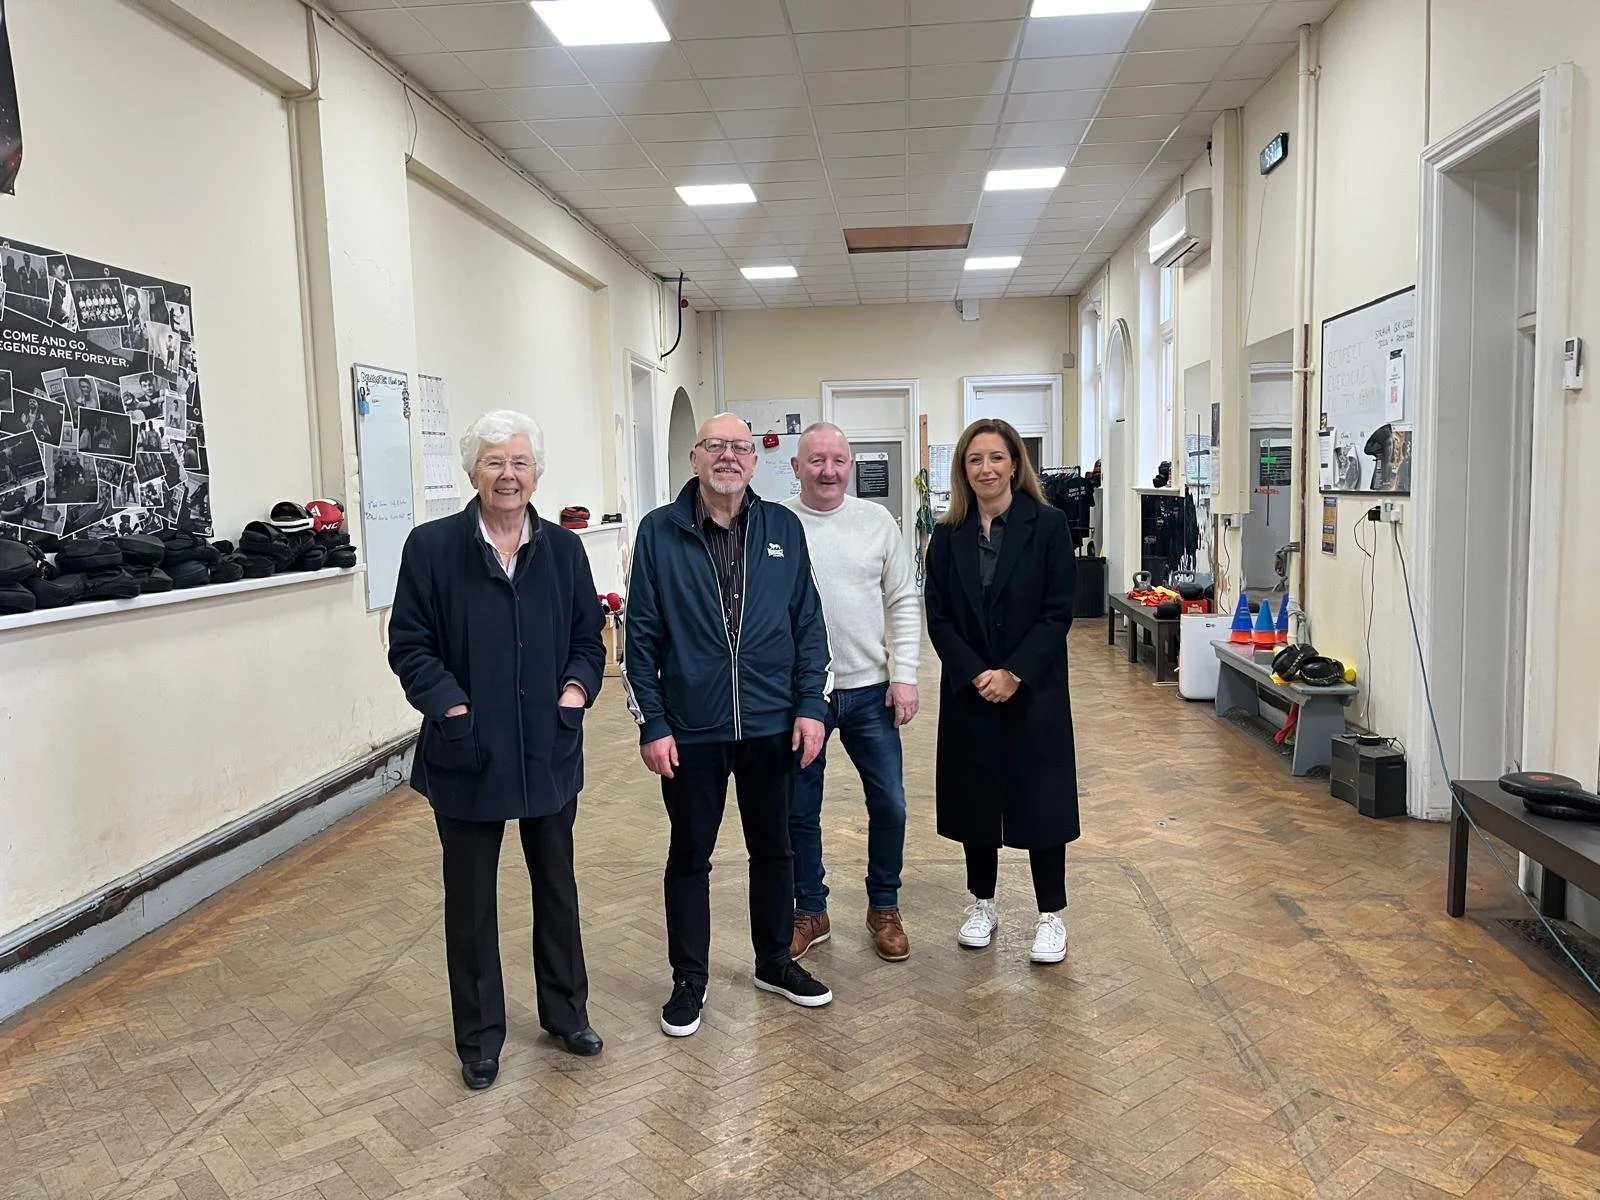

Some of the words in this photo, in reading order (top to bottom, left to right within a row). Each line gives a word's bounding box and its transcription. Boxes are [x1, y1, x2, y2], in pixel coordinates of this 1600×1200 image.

[3, 329, 39, 344] COME
[41, 336, 67, 348] AND
[69, 340, 89, 351] GO.
[49, 348, 73, 360] ARE
[75, 351, 130, 368] FOREVER.
[1327, 341, 1364, 369] RESPECT
